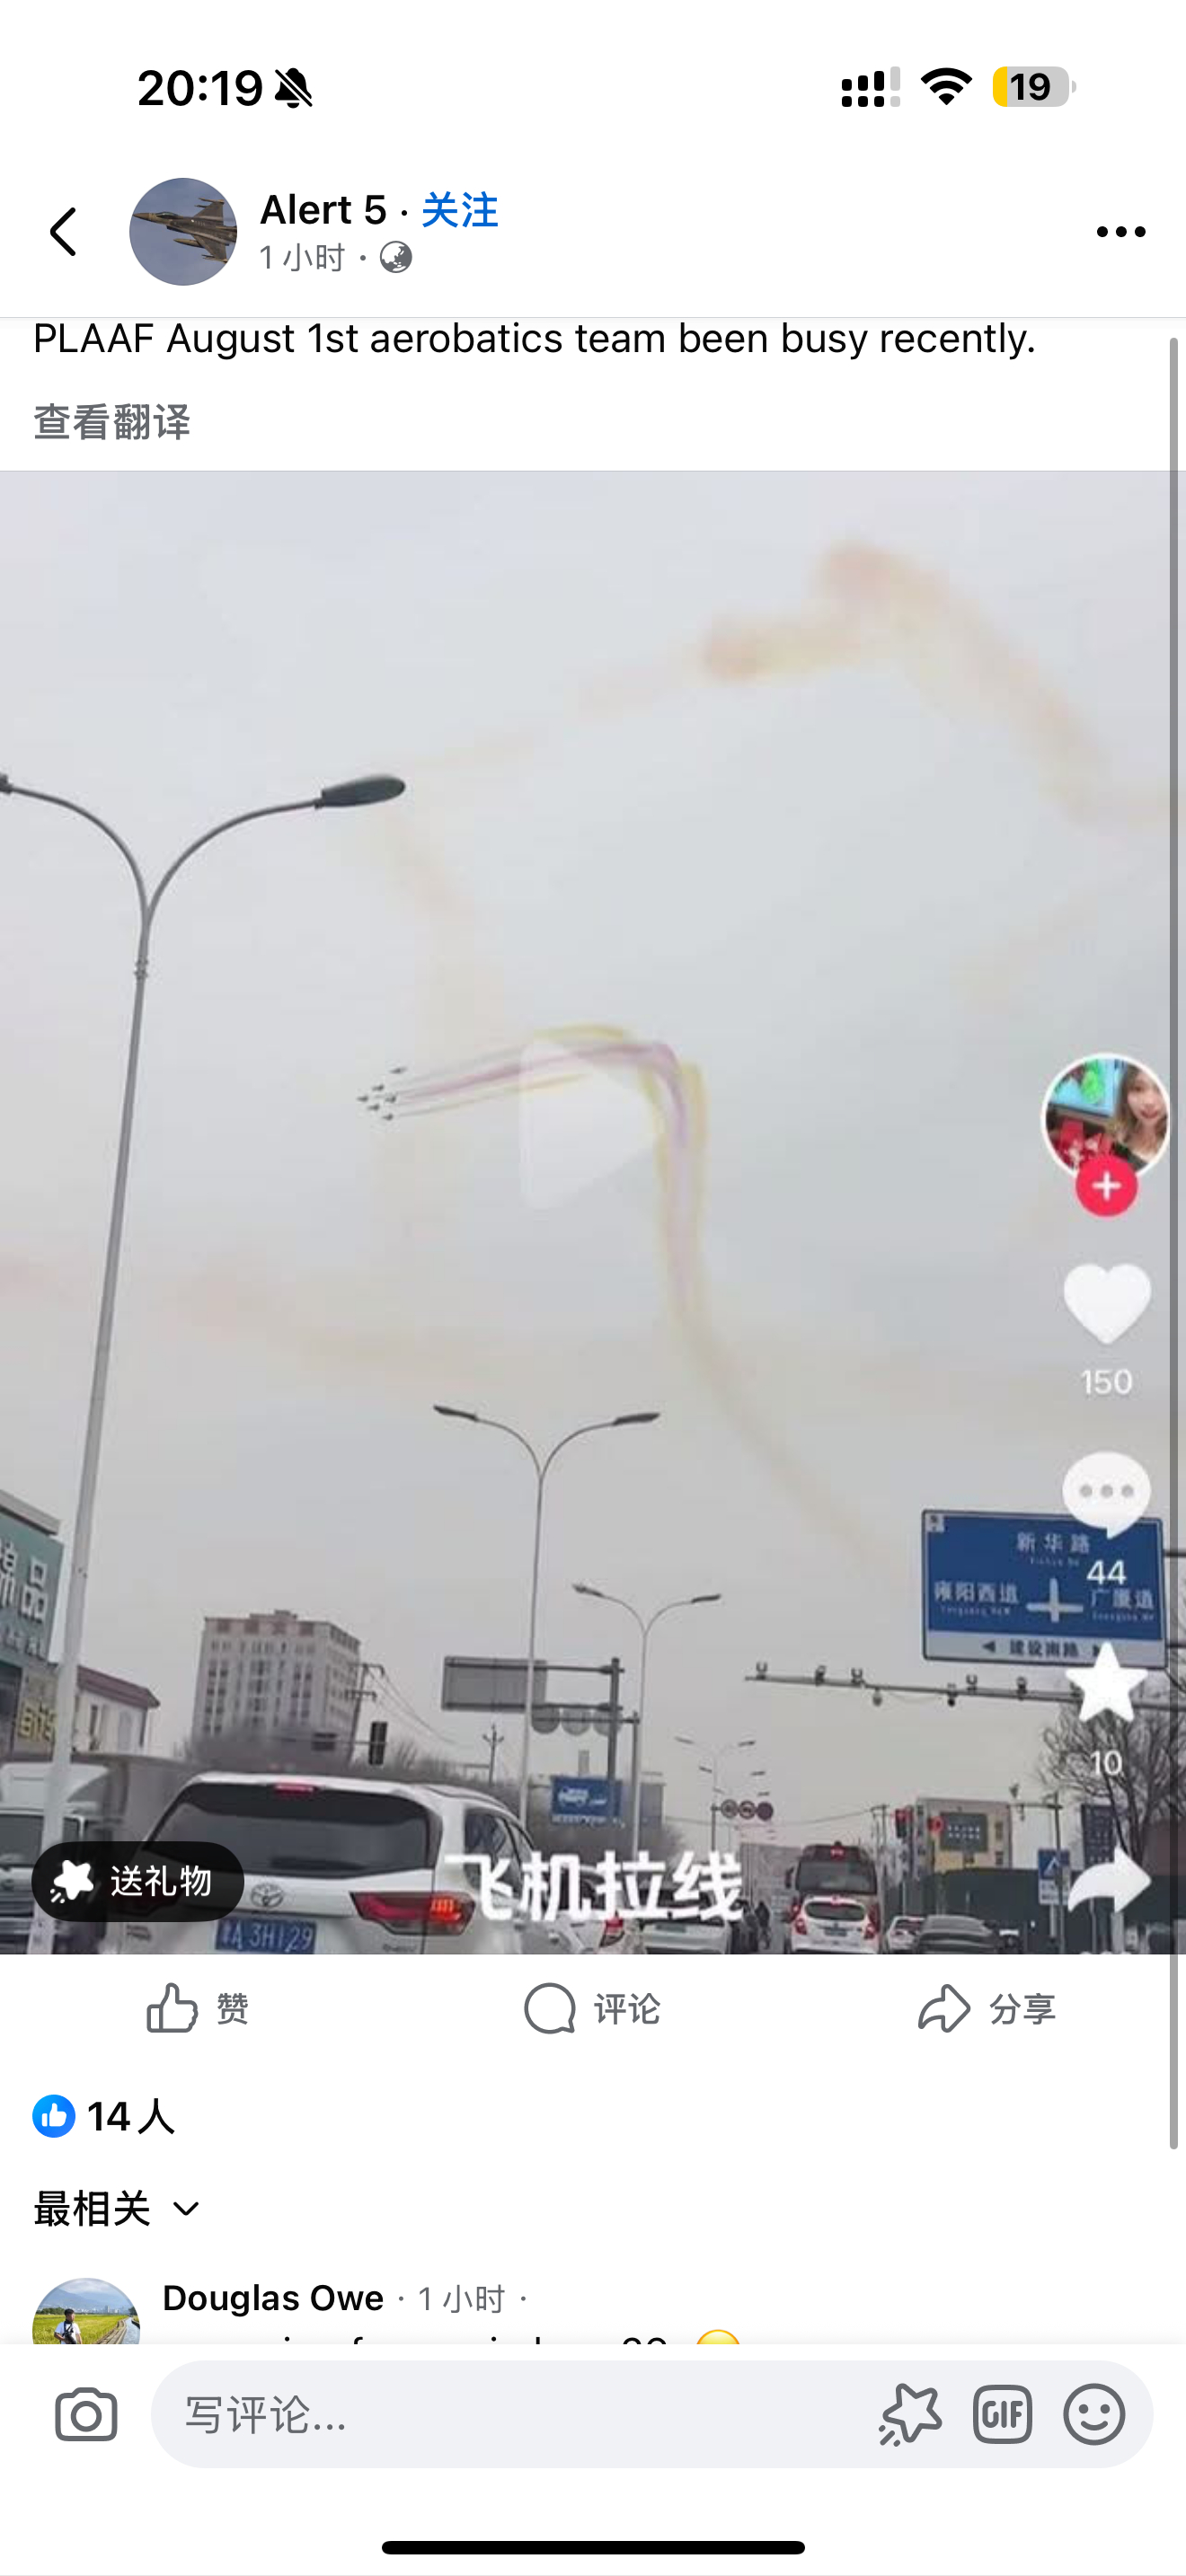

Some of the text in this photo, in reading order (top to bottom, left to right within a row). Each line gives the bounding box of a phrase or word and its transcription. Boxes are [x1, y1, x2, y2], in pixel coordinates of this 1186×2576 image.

[138, 70, 262, 106] 20:19
[1011, 73, 1050, 101] 19
[260, 193, 386, 225] Alert 5
[422, 191, 498, 228] 关注
[36, 322, 1034, 360] PLAAF August 1st aerobatics team been busy recently.
[34, 403, 190, 440] 查看翻译
[1017, 1531, 1090, 1554] 新华路
[217, 1993, 248, 2025] 赞
[594, 1993, 660, 2025] 评论
[989, 1993, 1056, 2025] 分享
[34, 2190, 150, 2227] 最相关
[164, 2284, 383, 2317] Douglas Owe
[982, 2400, 1023, 2429] GIF
